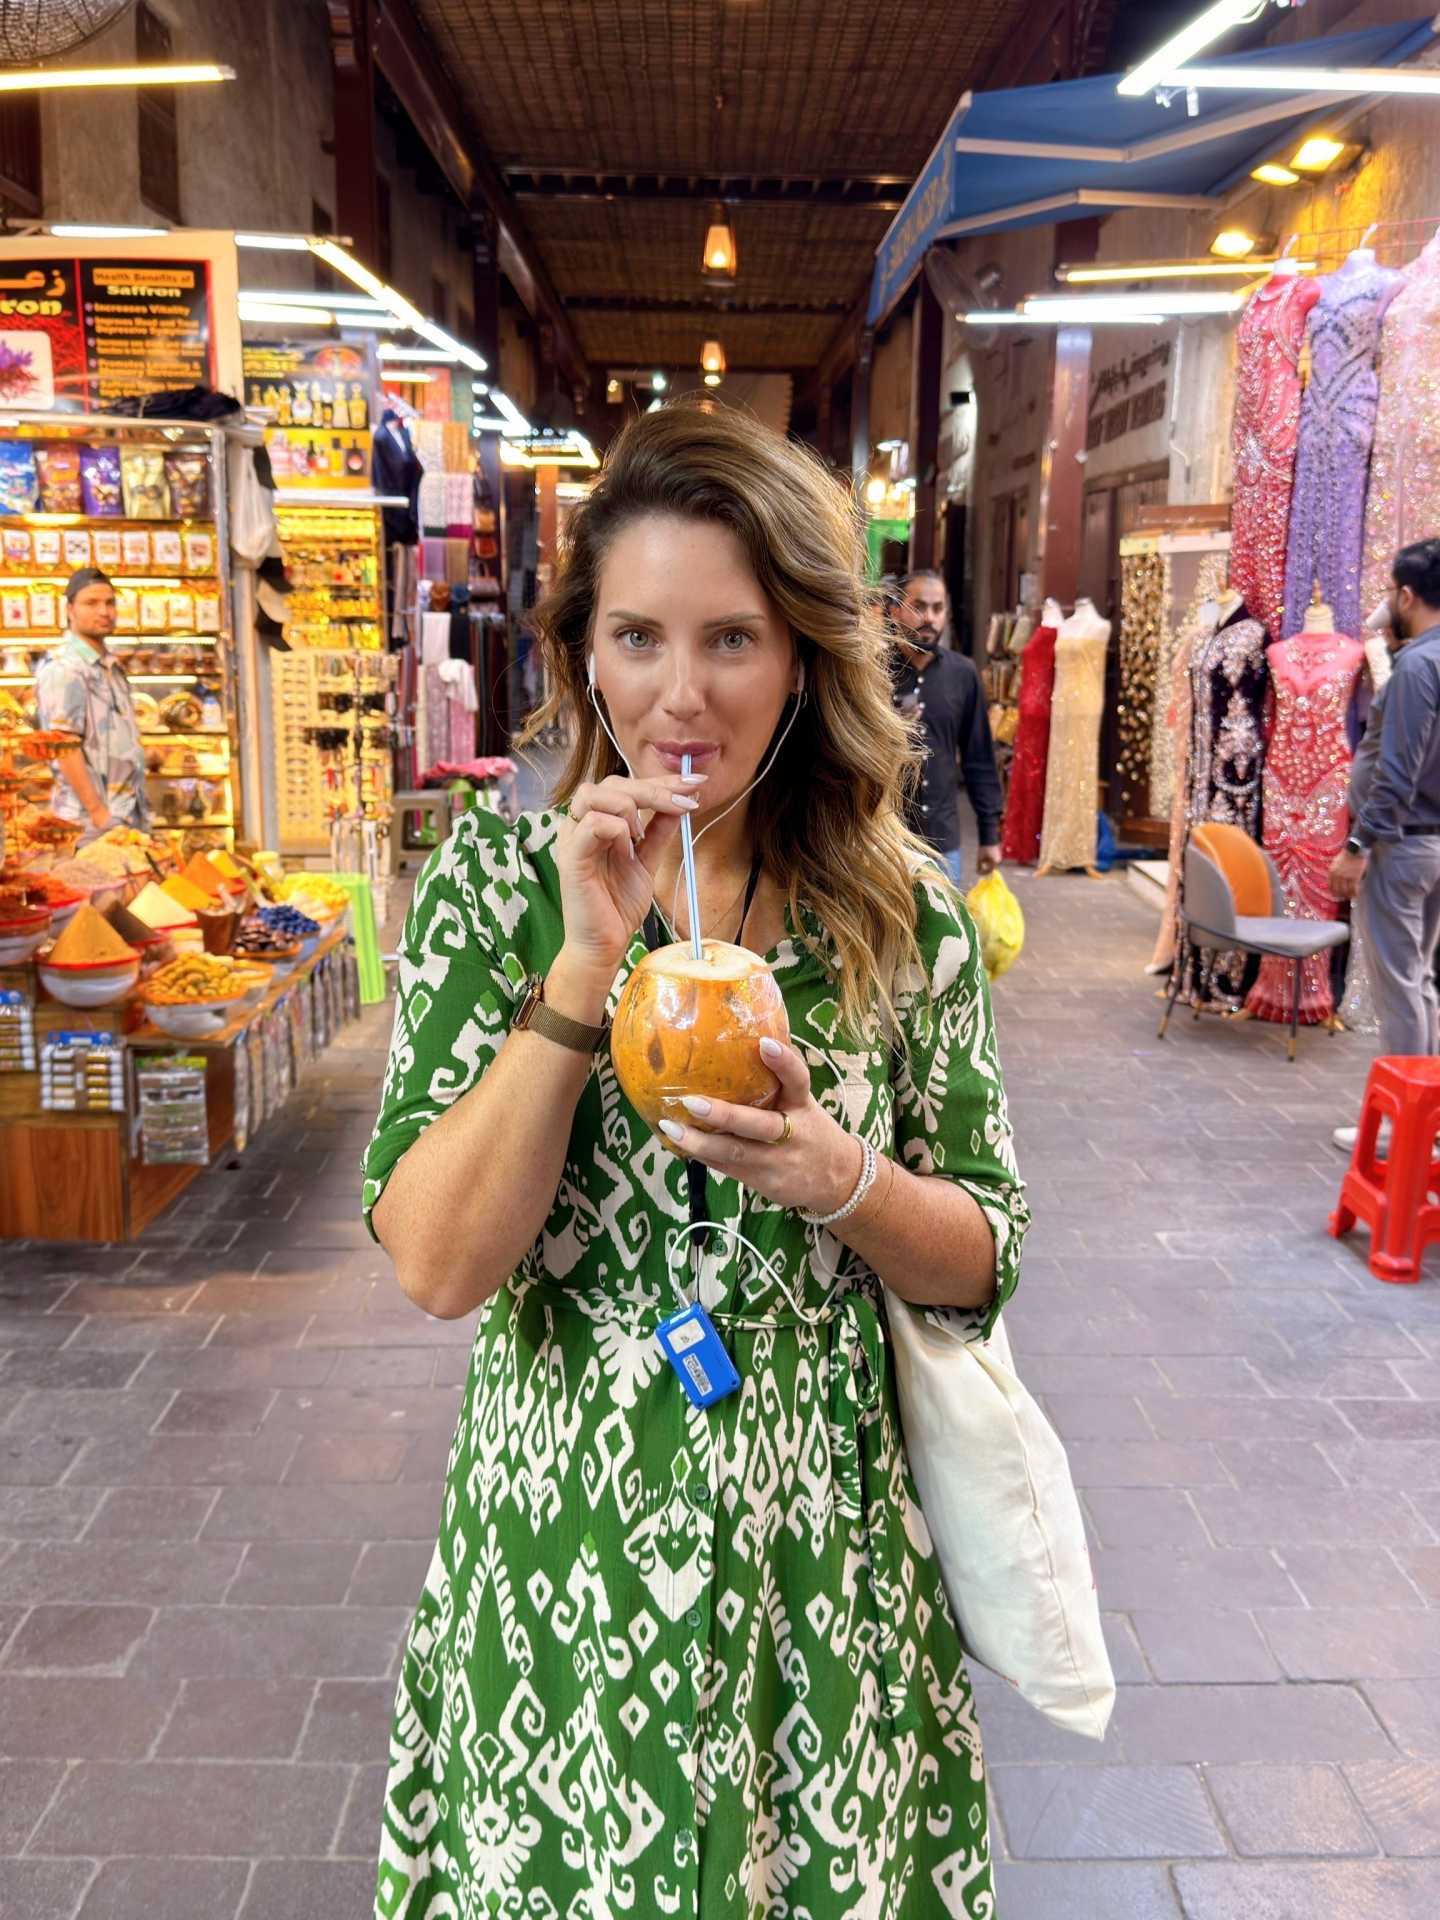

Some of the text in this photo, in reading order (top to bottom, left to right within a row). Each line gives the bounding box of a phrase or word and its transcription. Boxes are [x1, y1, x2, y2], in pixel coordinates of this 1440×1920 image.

[95, 272, 192, 283] Health Benefits of
[106, 285, 182, 298] Saffron
[94, 302, 192, 317] Increases Vitality
